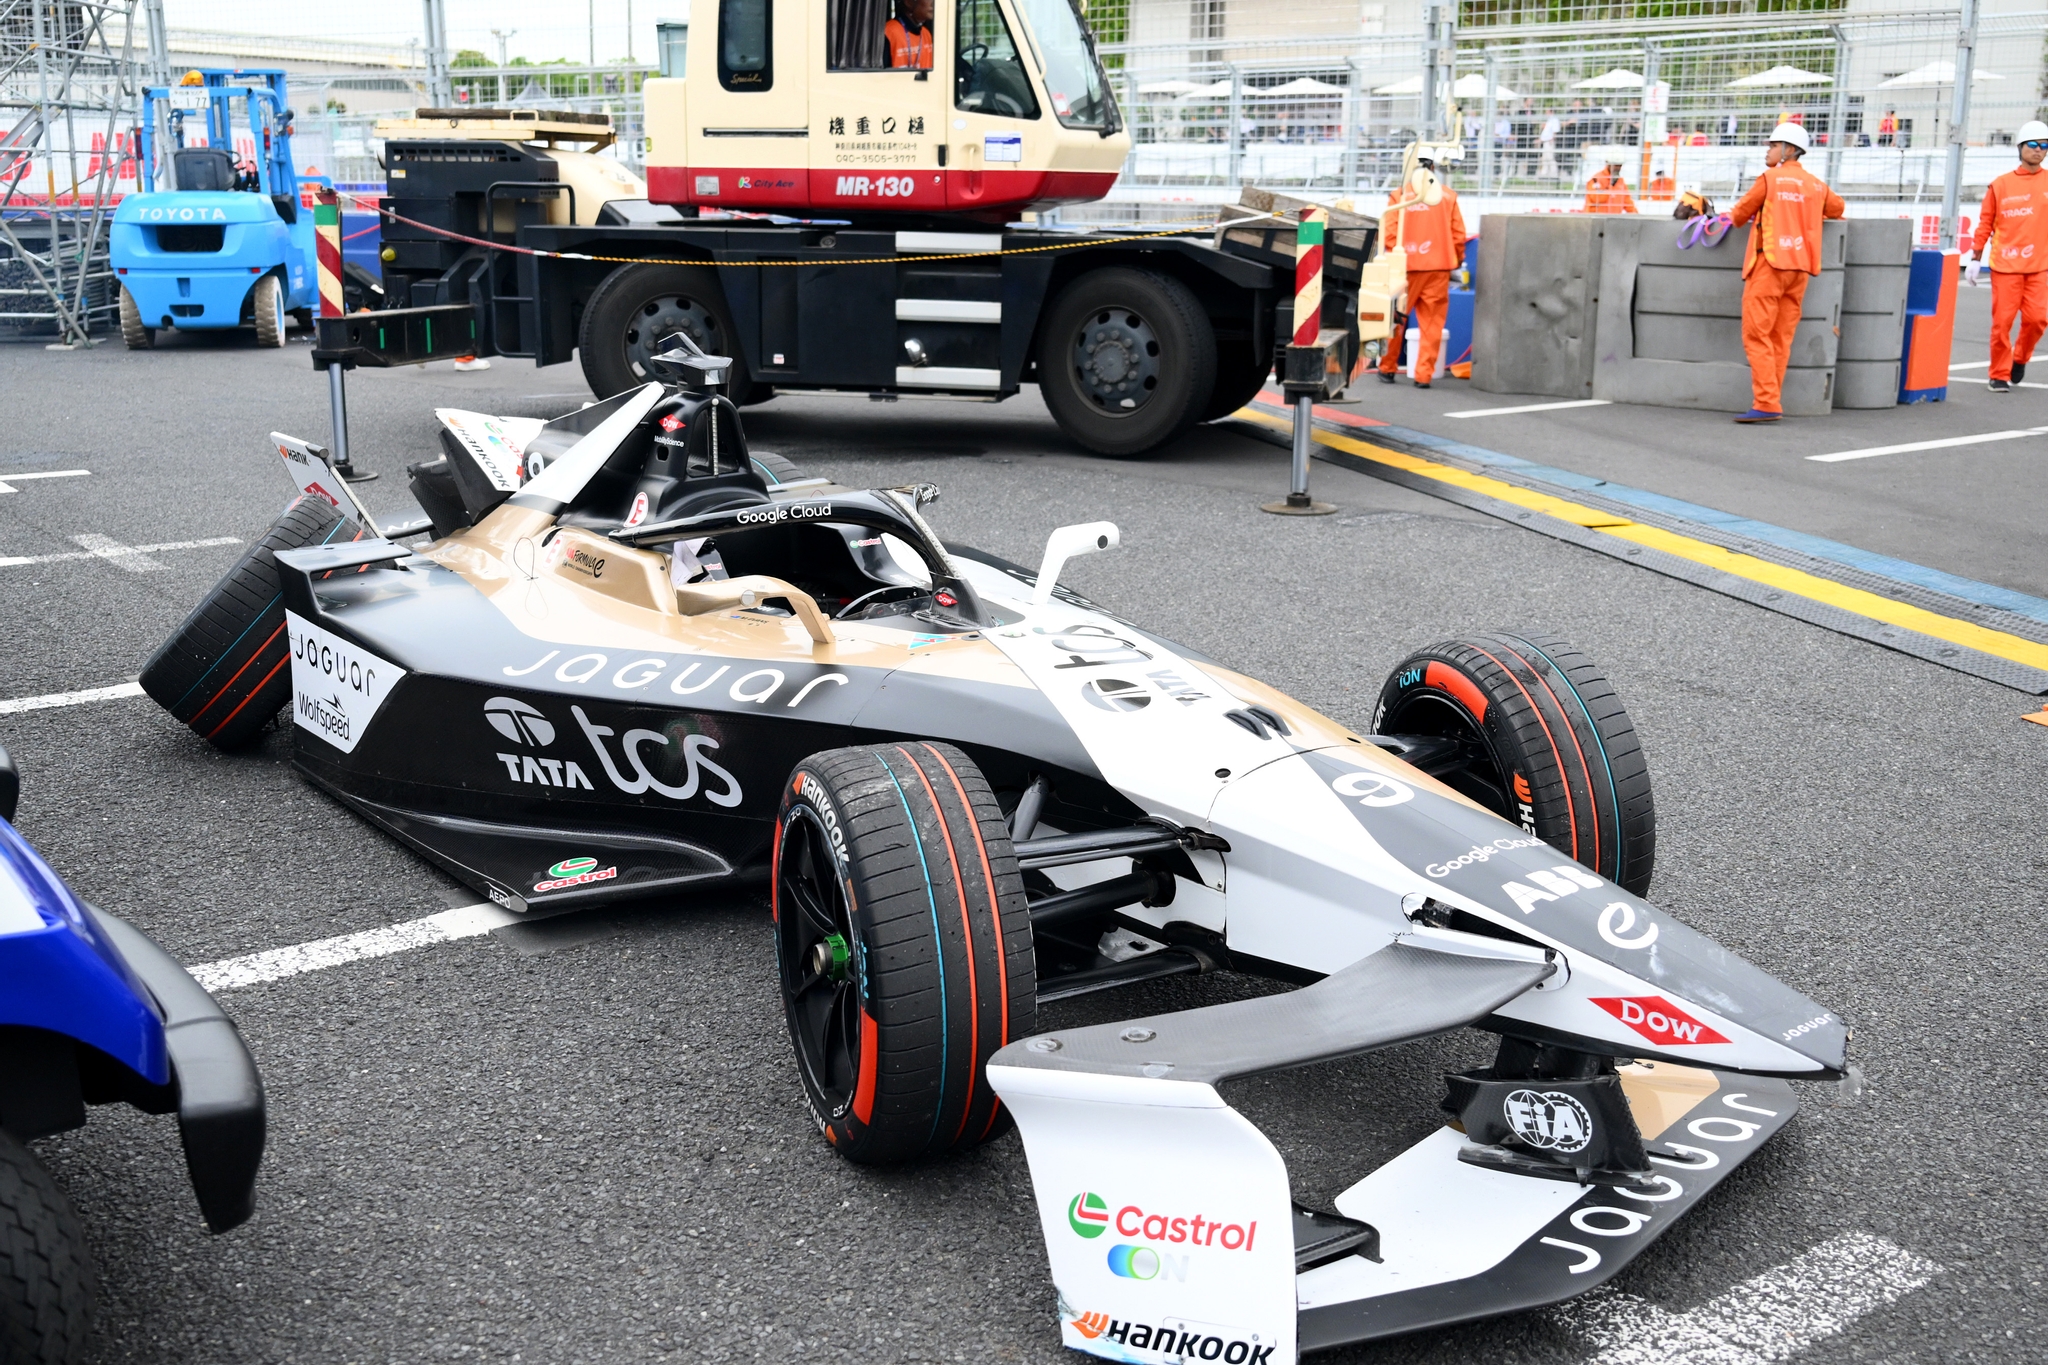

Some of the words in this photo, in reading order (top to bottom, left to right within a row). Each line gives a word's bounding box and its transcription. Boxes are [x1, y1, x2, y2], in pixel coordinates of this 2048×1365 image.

[836, 154, 917, 163] 090-3505-3777
[139, 208, 226, 221] TOYOTA
[1777, 191, 1806, 203] TRACK
[2001, 207, 2034, 218] TRACK
[736, 506, 788, 524] Google
[790, 502, 832, 519] Cloud
[298, 690, 350, 743] Wolfspeed
[496, 752, 595, 791] TATA
[571, 704, 743, 808] tcs
[1331, 771, 1415, 808] 9
[1425, 844, 1498, 878] Google
[1493, 836, 1548, 851] Cloud
[534, 867, 617, 892] Castrol
[1501, 865, 1604, 915] ABB
[1115, 1205, 1258, 1252] Castrol
